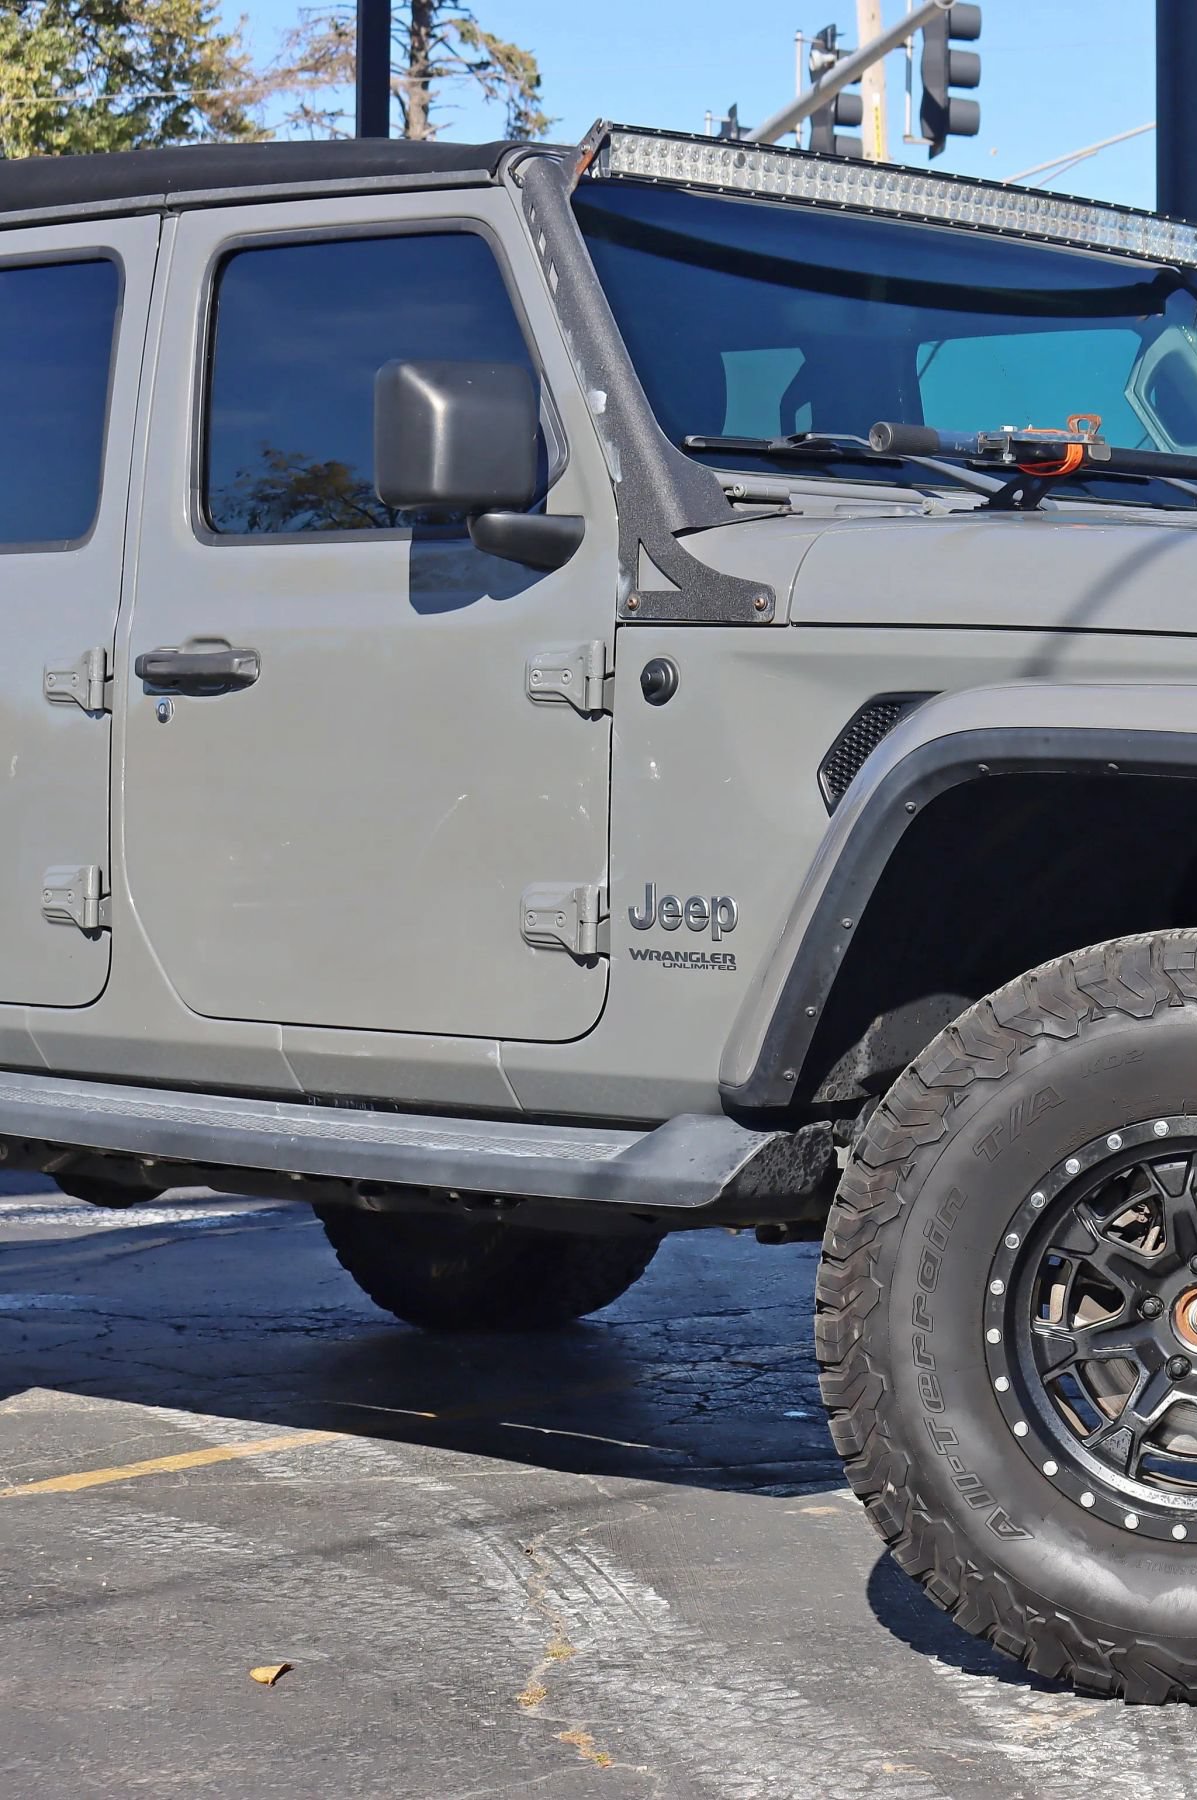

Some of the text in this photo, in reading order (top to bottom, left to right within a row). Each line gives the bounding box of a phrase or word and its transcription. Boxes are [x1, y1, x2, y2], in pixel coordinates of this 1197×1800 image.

[628, 882, 738, 941] Jeep
[629, 947, 736, 965] WRANGLER
[662, 961, 737, 971] UNLIMITED
[972, 1086, 1067, 1163] T/A
[912, 1186, 1035, 1542] All-Terrain
